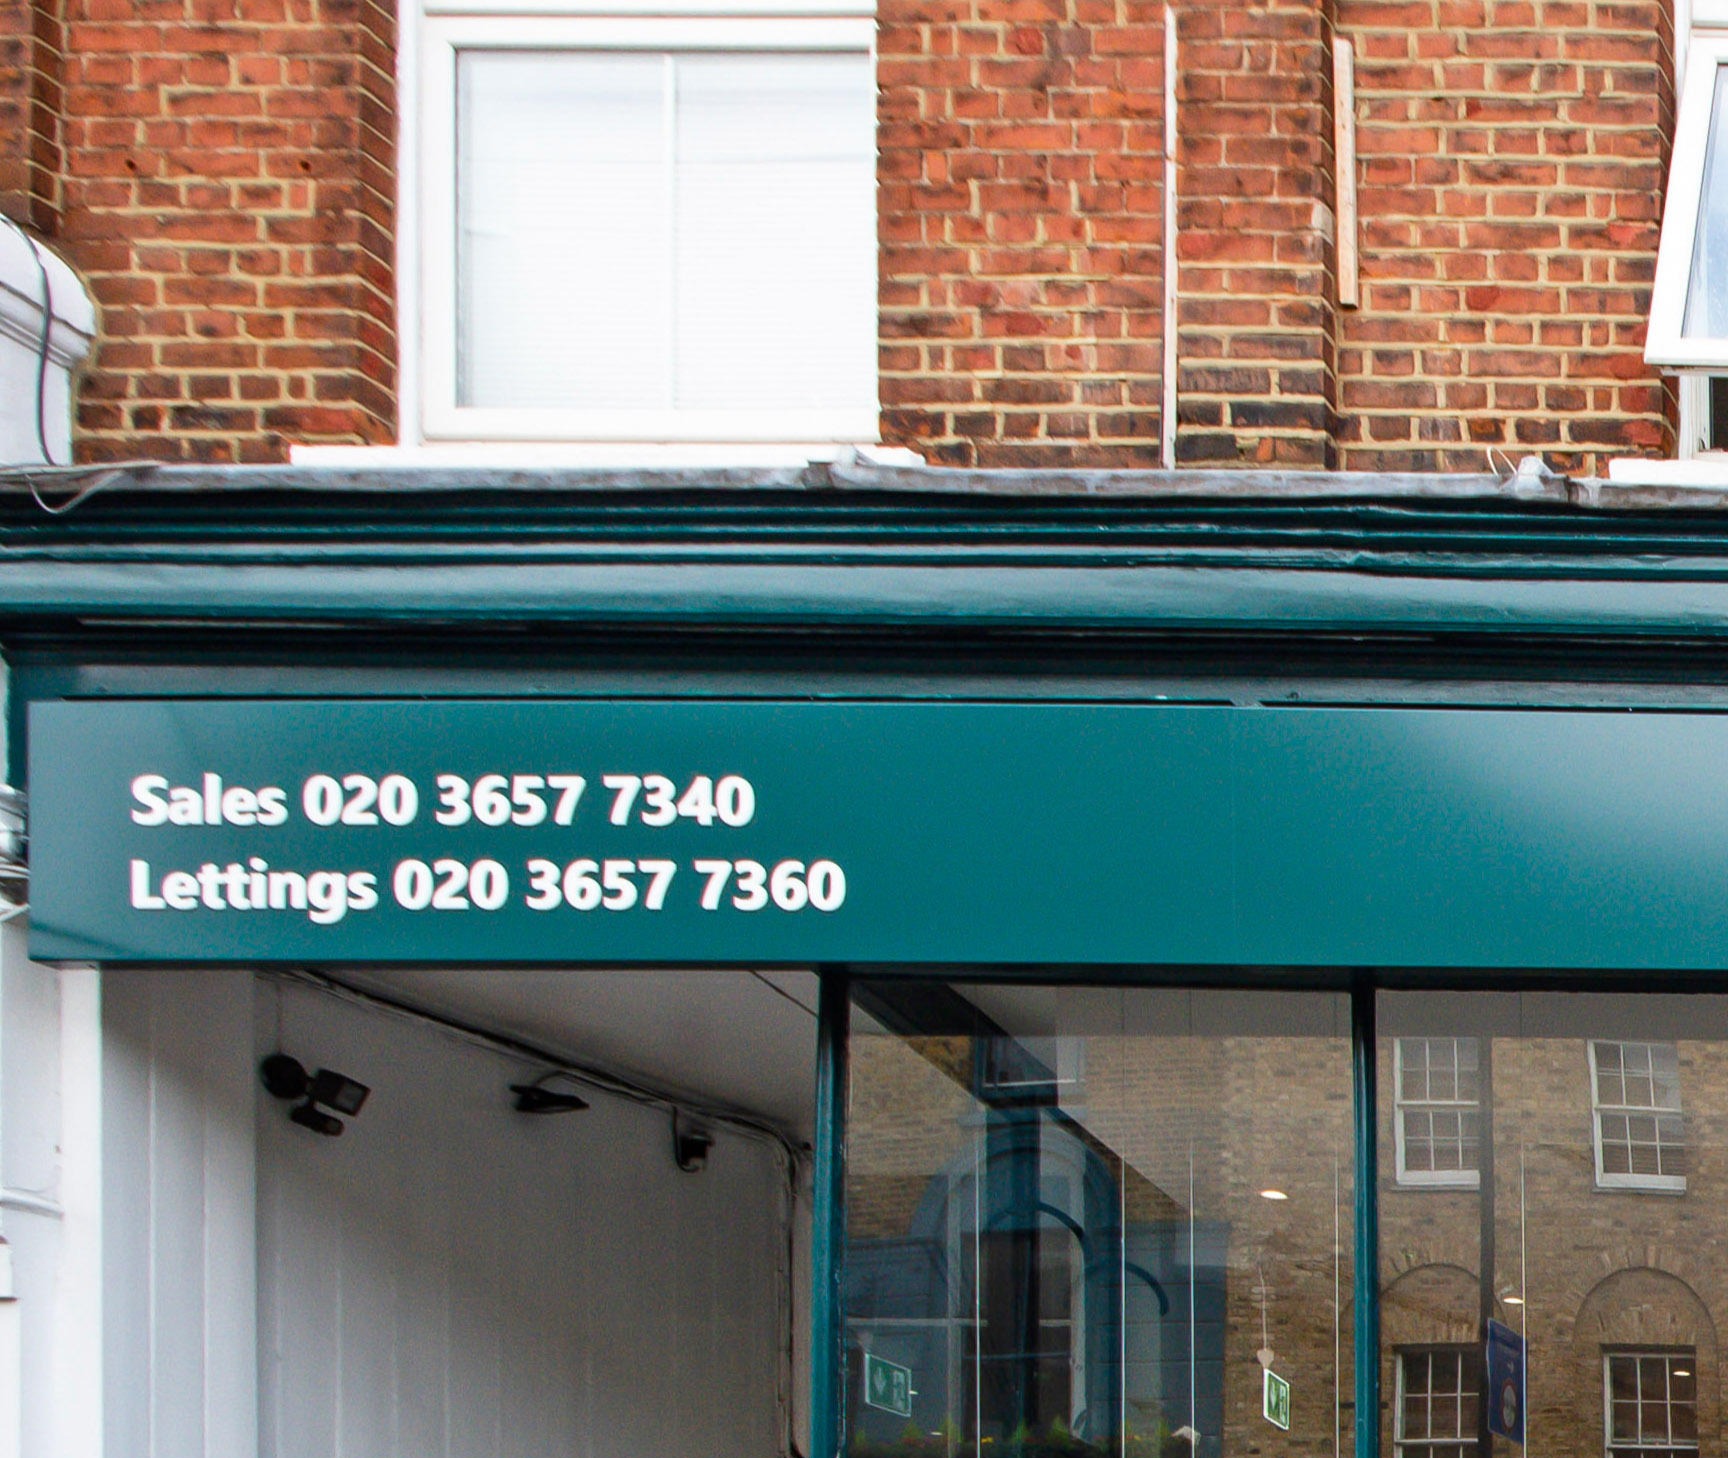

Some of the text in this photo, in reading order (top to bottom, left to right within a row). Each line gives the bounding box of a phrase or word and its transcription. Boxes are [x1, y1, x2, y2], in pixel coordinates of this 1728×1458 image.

[132, 773, 755, 826] Sales 020 3657 7340
[131, 857, 846, 924] Lettings 020 3657 7360
